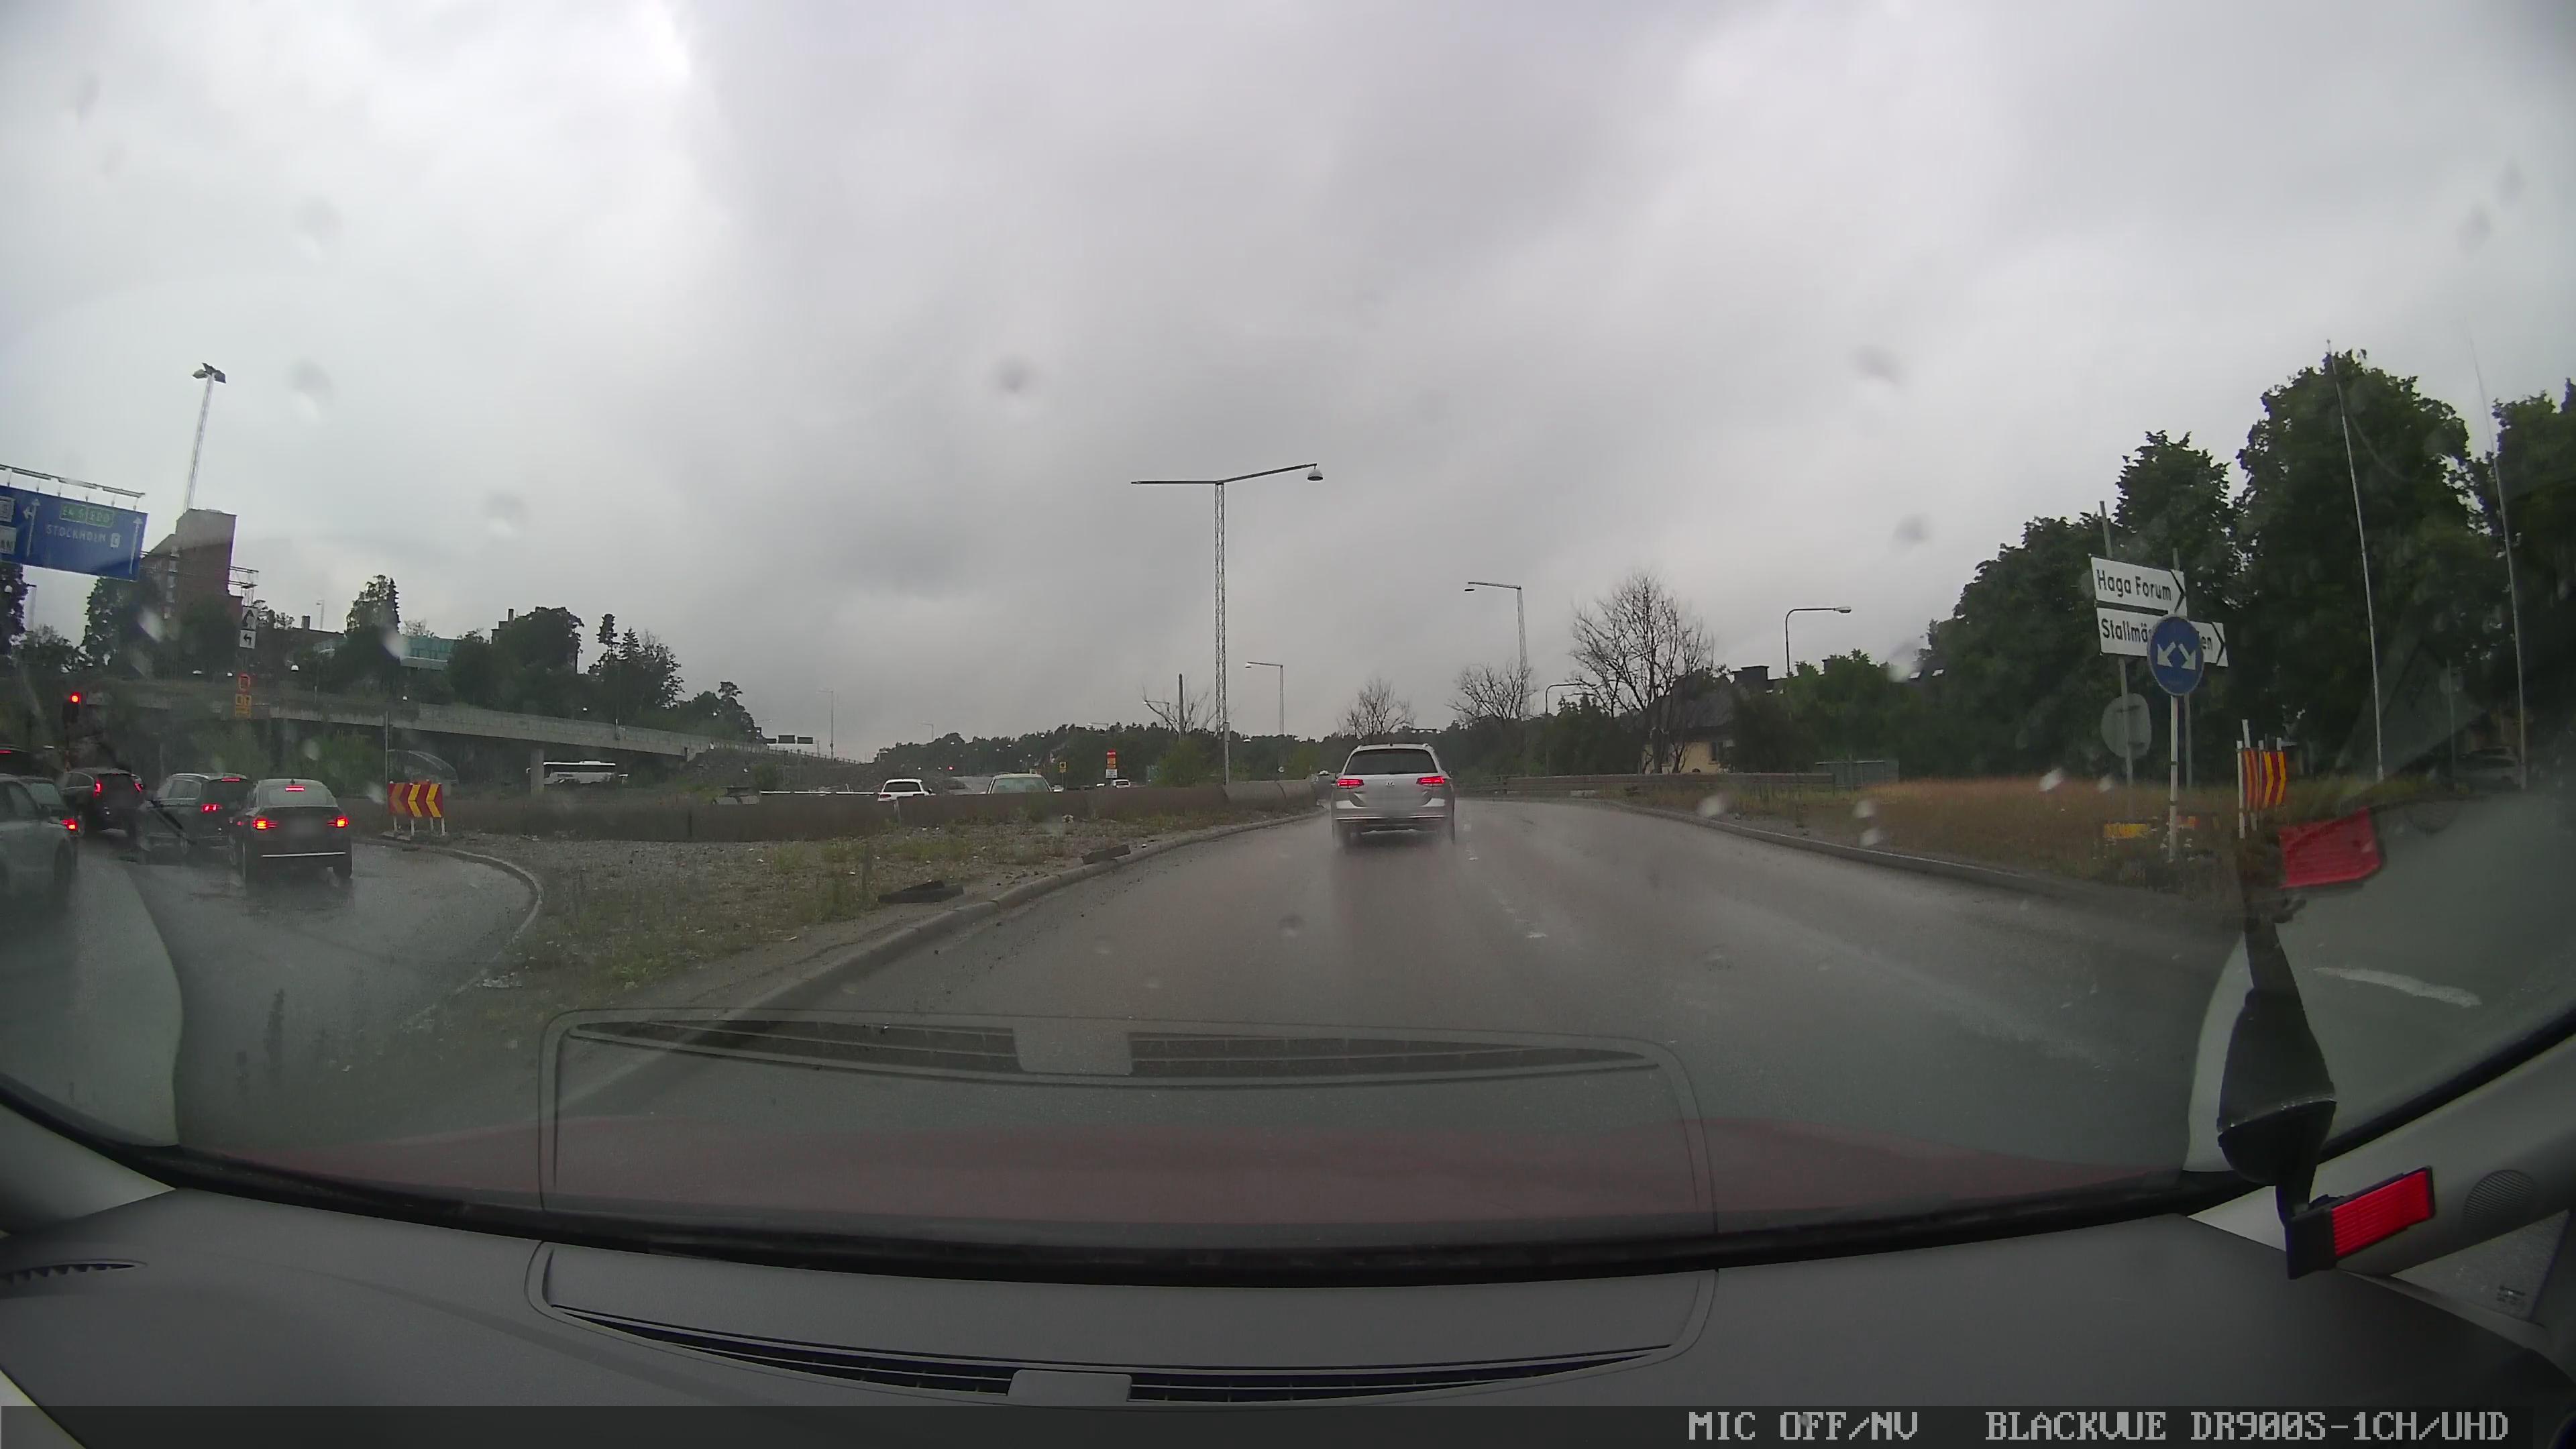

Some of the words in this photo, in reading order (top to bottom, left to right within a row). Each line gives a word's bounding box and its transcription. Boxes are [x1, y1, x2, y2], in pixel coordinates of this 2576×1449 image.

[46, 524, 106, 543] STOCKHOLM
[2096, 569, 2131, 597] Haga
[2135, 576, 2171, 601] Forum
